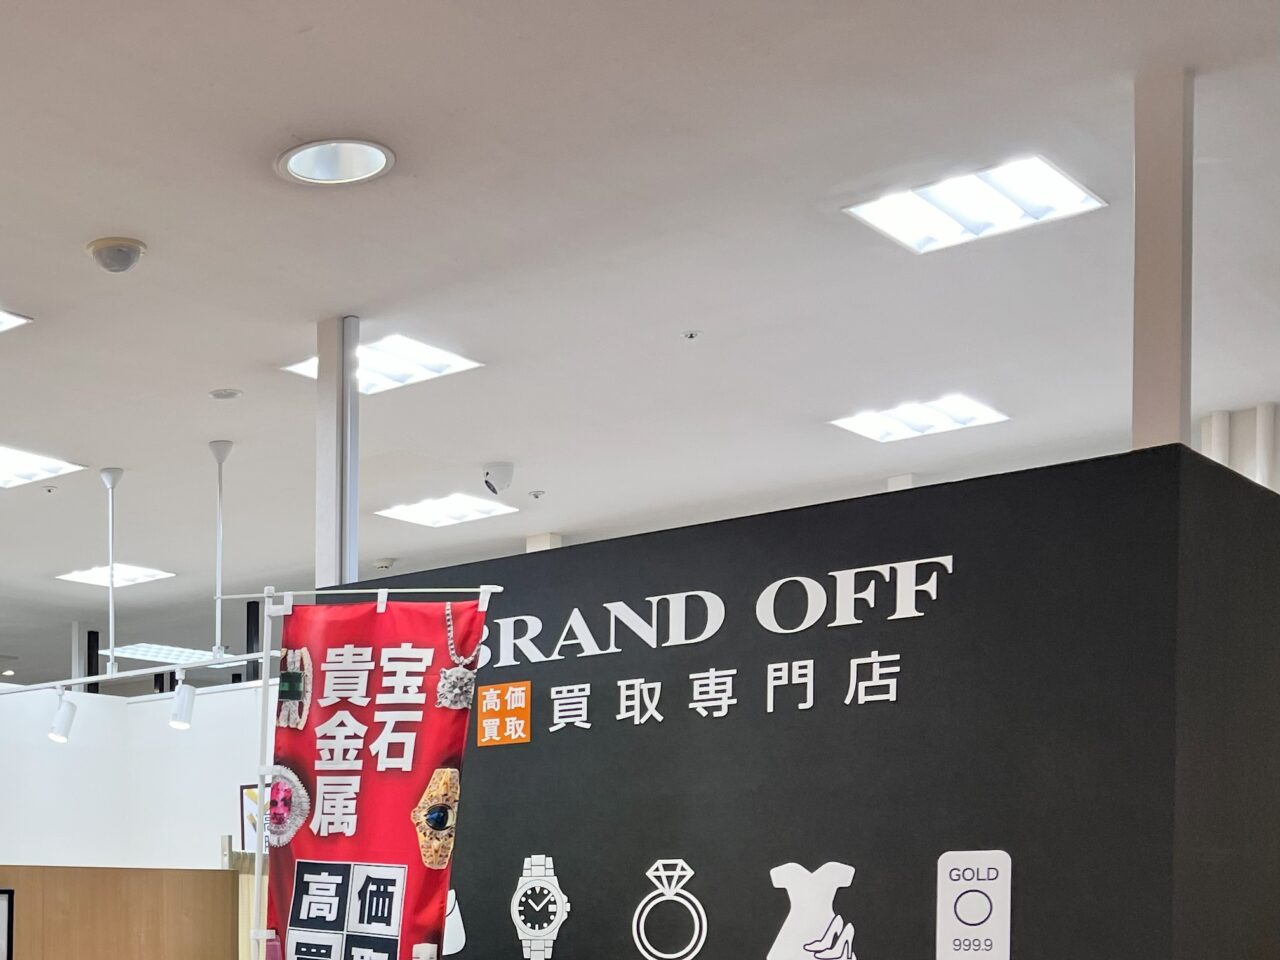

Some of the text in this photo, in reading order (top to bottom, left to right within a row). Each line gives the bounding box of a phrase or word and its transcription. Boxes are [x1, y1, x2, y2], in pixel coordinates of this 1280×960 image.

[755, 555, 954, 635] OFF
[369, 643, 435, 772] 宝石
[481, 685, 526, 712] 高価
[549, 650, 901, 734] 買取専門店
[309, 644, 375, 837] 貴金属
[481, 716, 526, 741] 買取
[299, 872, 397, 927] 高価
[948, 867, 999, 882] GOLD
[952, 938, 993, 952] 999.9
